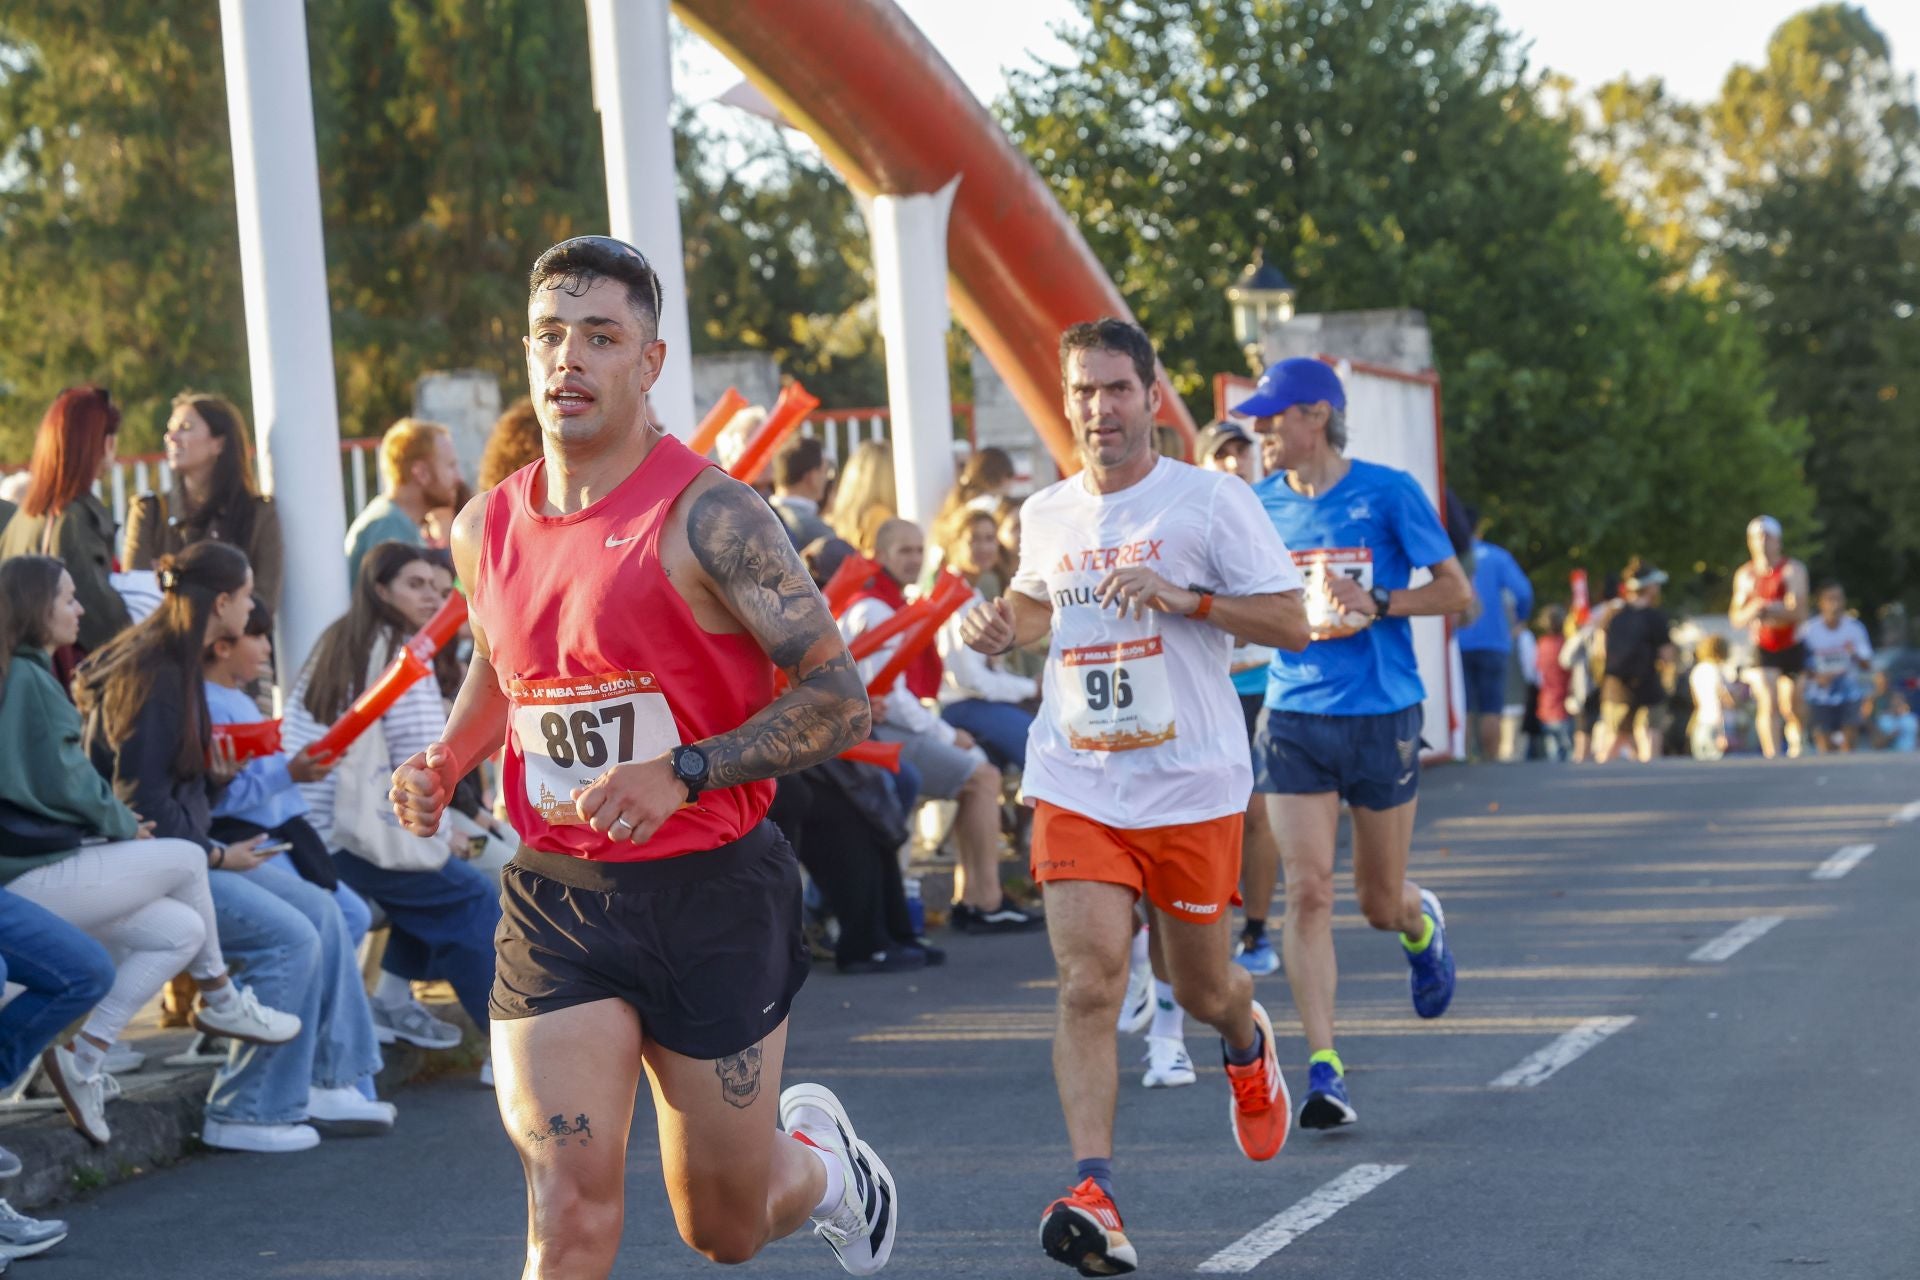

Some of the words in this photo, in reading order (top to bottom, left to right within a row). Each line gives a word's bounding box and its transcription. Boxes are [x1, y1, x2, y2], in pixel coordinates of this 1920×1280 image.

[1081, 539, 1164, 572] TERREX
[546, 687, 576, 698] MBA
[600, 677, 636, 693] GIJÓN
[1086, 667, 1133, 711] 96
[541, 702, 635, 769] 867
